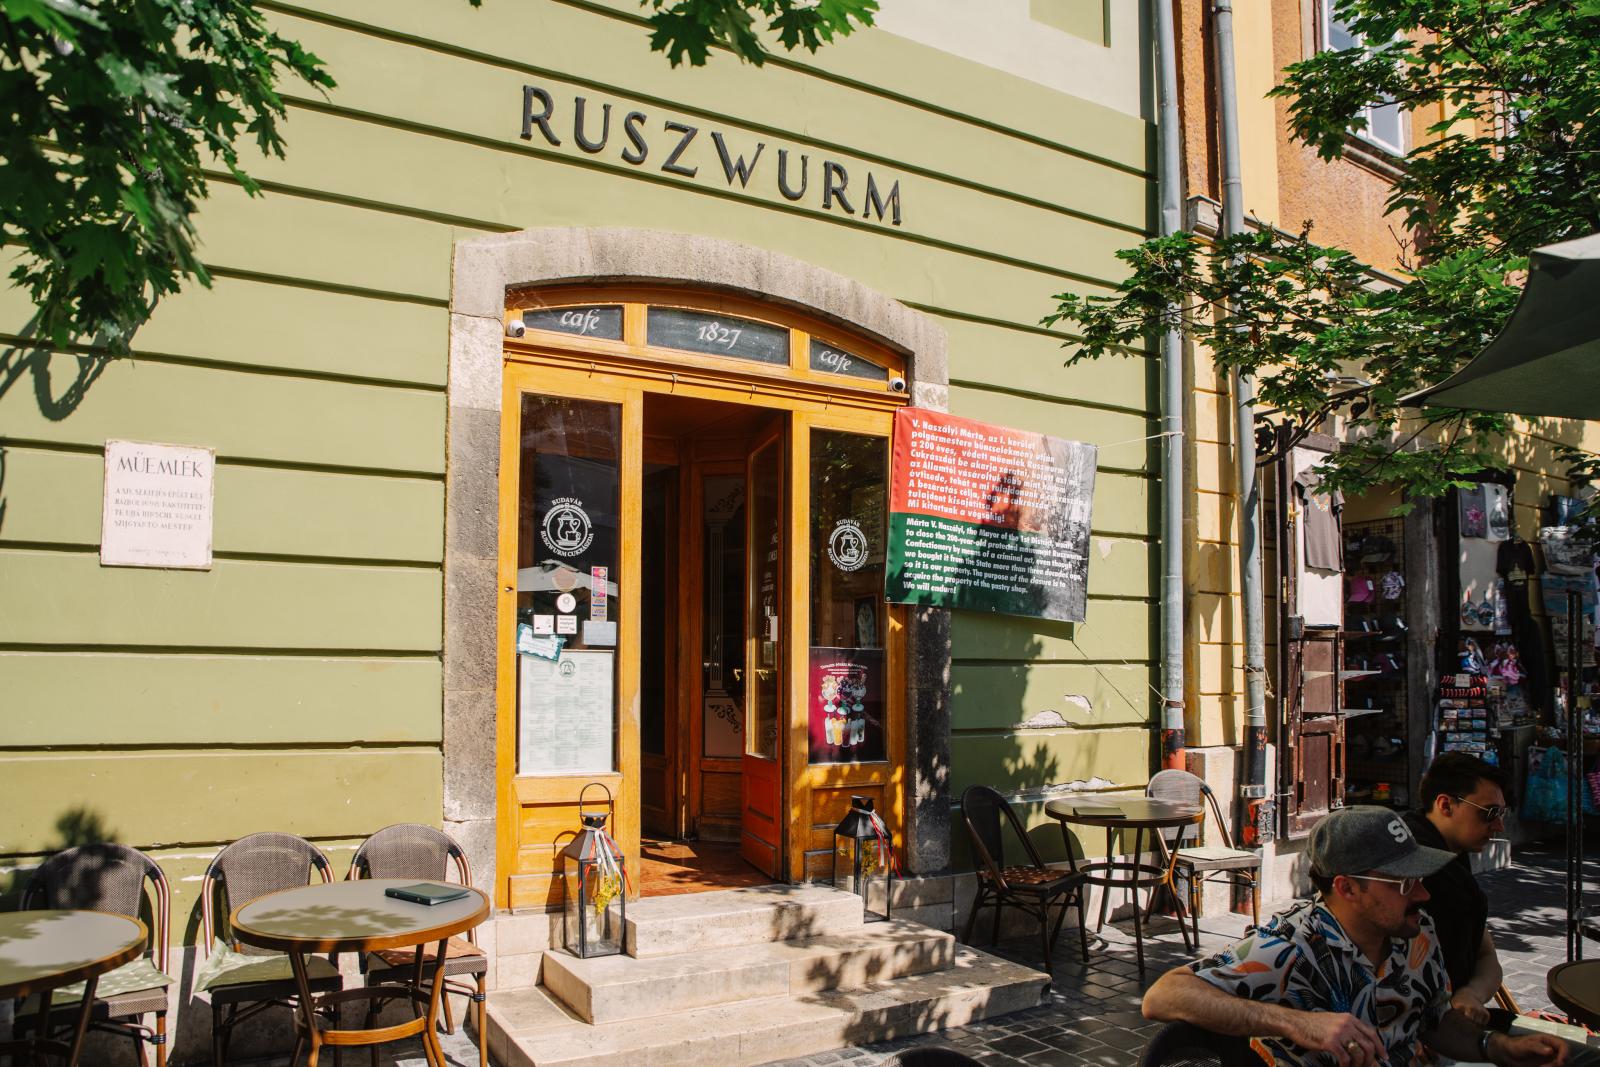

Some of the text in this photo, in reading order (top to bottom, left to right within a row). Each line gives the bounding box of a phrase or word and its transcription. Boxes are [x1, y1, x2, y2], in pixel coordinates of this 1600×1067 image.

[520, 84, 902, 226] RUSZWURM
[698, 321, 742, 350] 1827
[912, 419, 920, 427] V.
[919, 440, 934, 450] 200
[958, 457, 968, 466] be
[970, 459, 997, 472] akarja
[979, 481, 989, 489] mi
[552, 497, 582, 507] BUDAVÁR
[981, 491, 1001, 503] hogy
[907, 499, 918, 508] Mi
[922, 500, 957, 514] kitartunk
[906, 517, 929, 527] Márta
[966, 526, 977, 534] the
[978, 528, 998, 539] Mayor
[540, 530, 567, 556] RUSZWURM
[916, 528, 933, 538] close
[935, 531, 945, 539] the
[946, 533, 986, 547] 200-year-old
[987, 541, 1017, 551] protected
[953, 545, 960, 553] by
[996, 551, 1022, 561] criminal
[917, 550, 942, 561] bought
[950, 555, 964, 563] from
[1027, 566, 1044, 574] three
[903, 570, 930, 581] acquire
[931, 573, 943, 581] the
[944, 576, 972, 586] property
[991, 582, 1010, 592] pastry
[943, 564, 971, 575] property.
[984, 572, 1007, 580] purpose
[1030, 576, 1051, 585] closure
[930, 583, 956, 593] endure!
